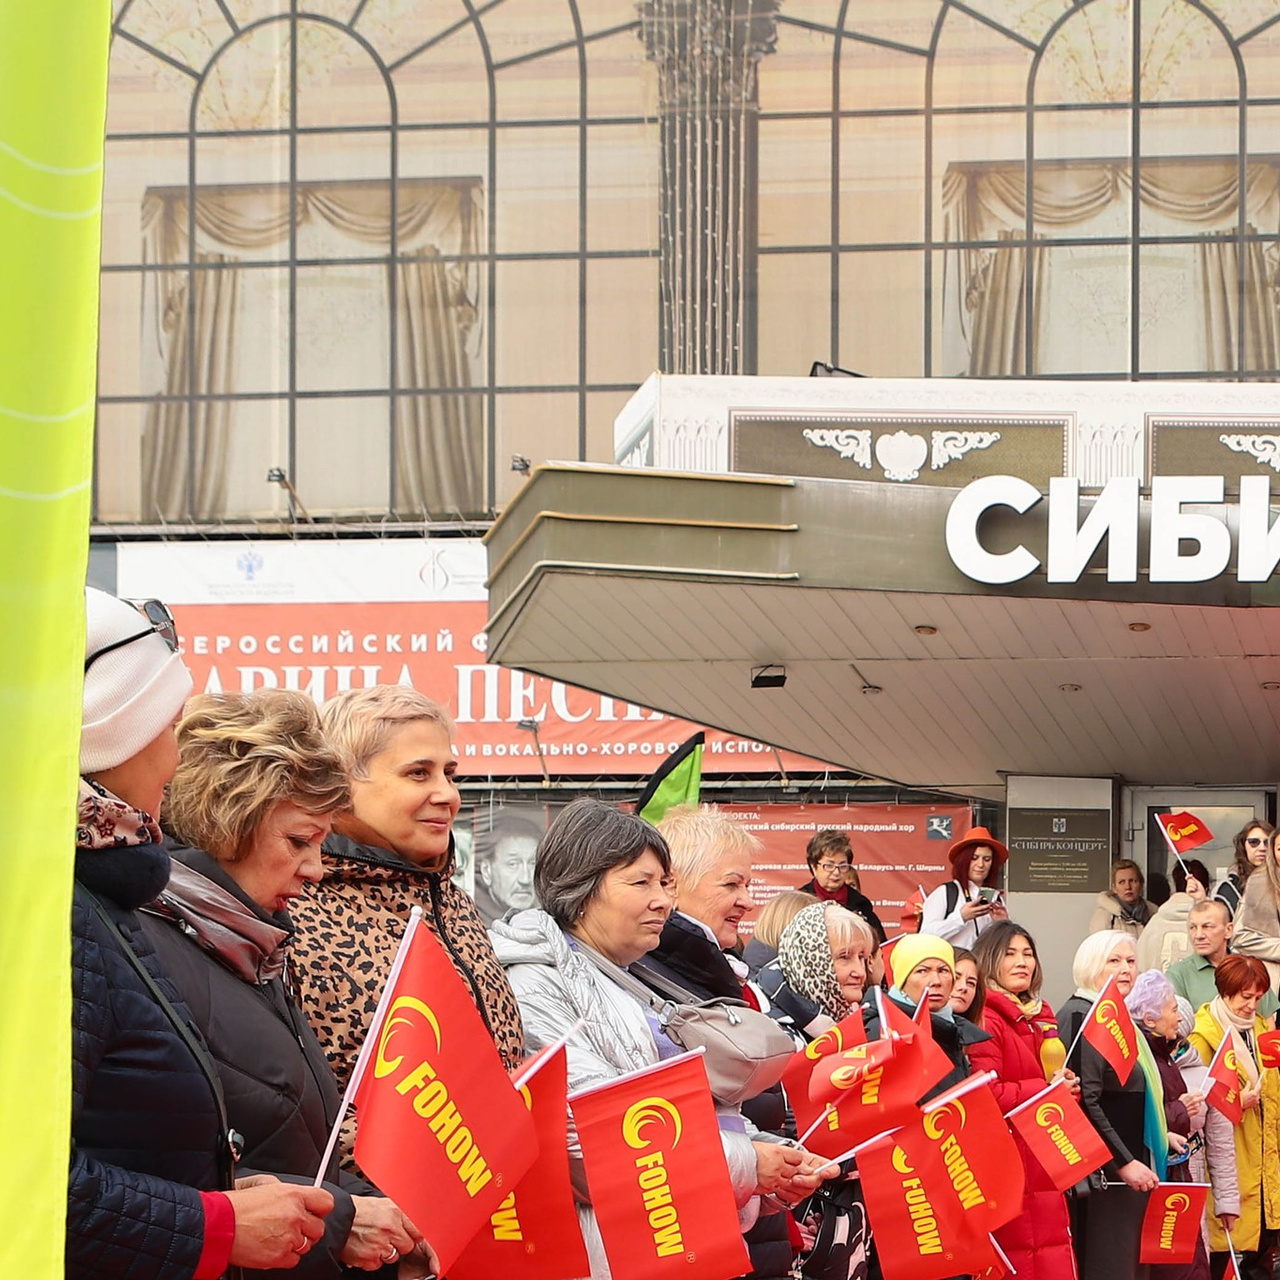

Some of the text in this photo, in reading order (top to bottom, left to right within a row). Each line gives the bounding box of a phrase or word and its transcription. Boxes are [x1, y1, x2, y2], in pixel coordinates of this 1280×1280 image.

[177, 629, 454, 655] СЕРОССИЙСКИЙ
[770, 823, 815, 831] сибирский
[853, 824, 897, 833] народный
[898, 825, 915, 833] хор
[394, 1060, 494, 1198] FOHOW
[1046, 1123, 1083, 1166] FOHOW
[939, 1133, 986, 1211] FOHOW
[635, 1150, 686, 1258] FOHOW
[1159, 1211, 1178, 1249] FOHOW
